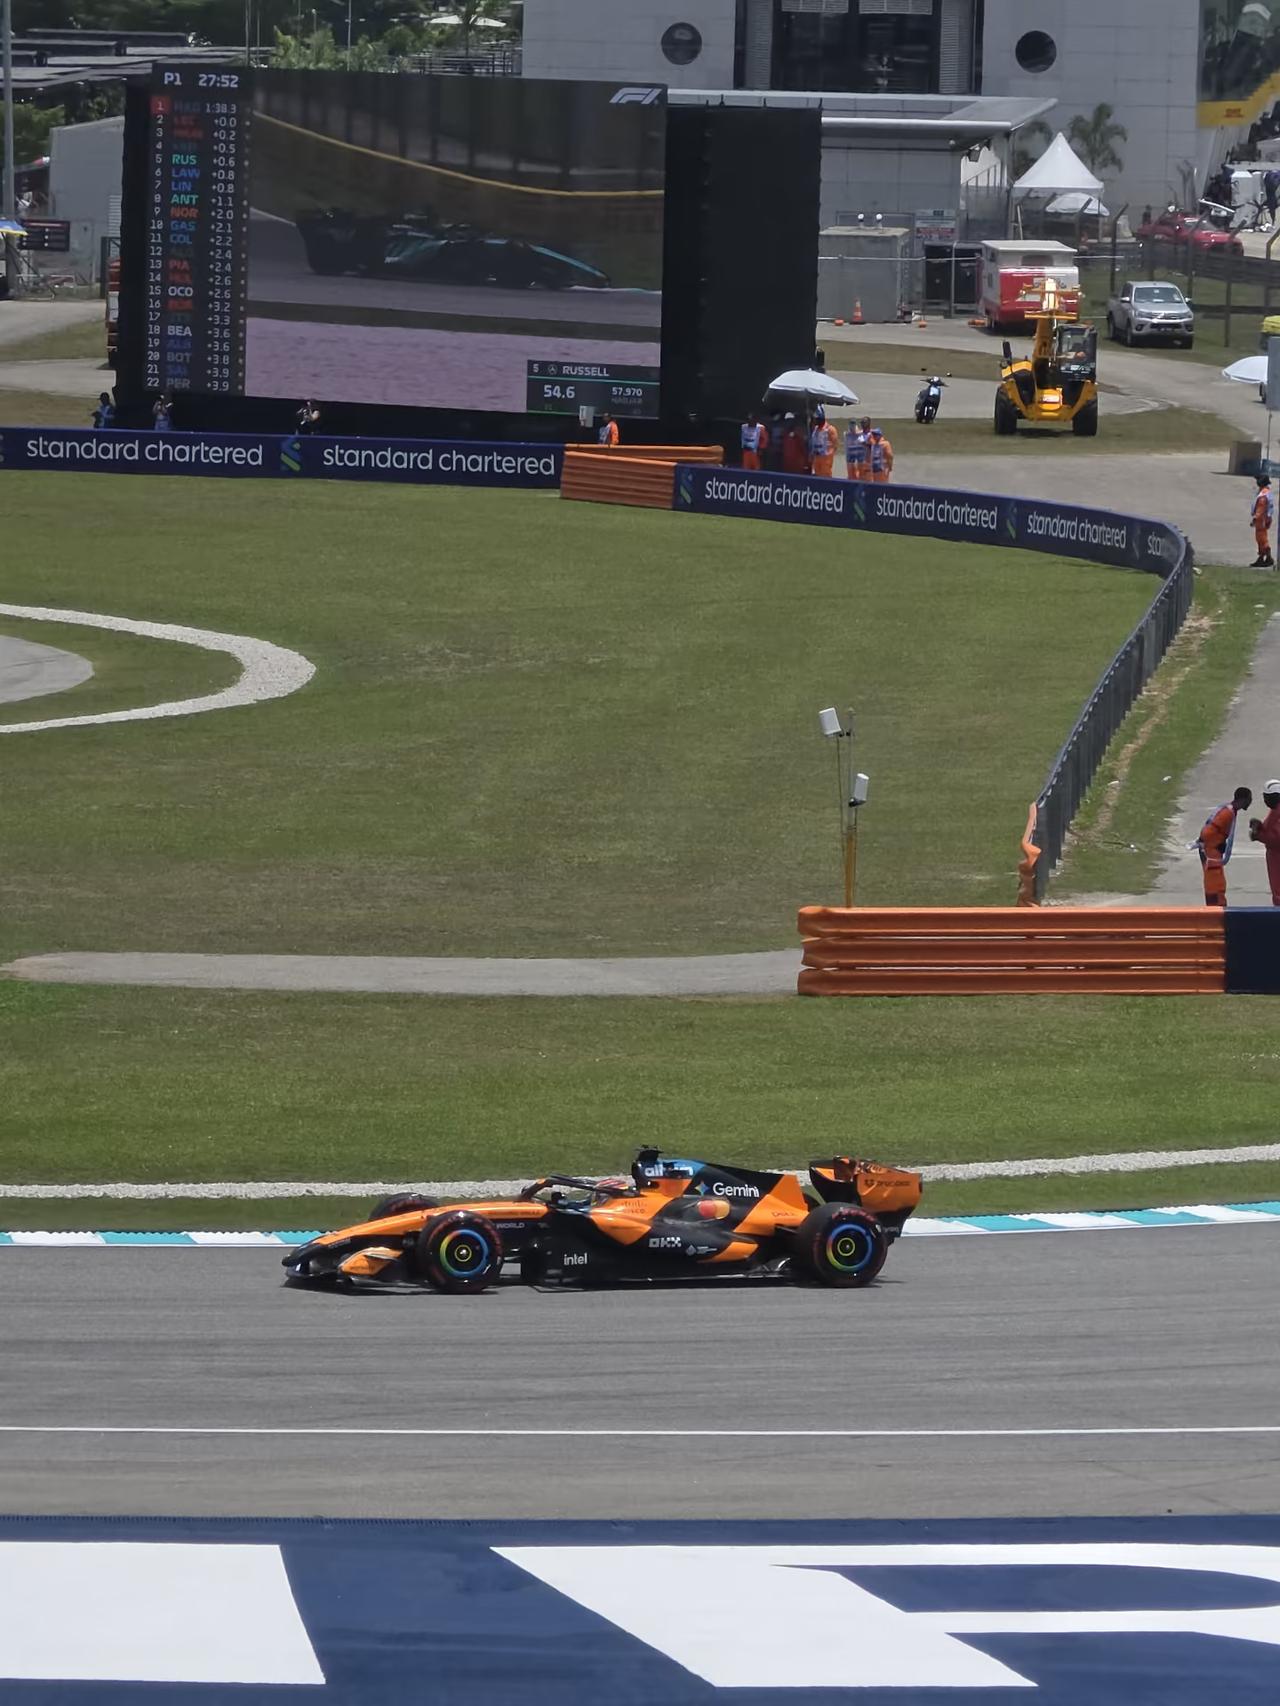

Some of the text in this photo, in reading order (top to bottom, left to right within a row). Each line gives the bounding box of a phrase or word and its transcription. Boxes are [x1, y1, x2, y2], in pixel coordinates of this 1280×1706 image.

[164, 72, 239, 88] P1 27:52
[156, 115, 164, 123] 2
[156, 128, 164, 136] 3
[155, 154, 163, 163] 5
[173, 154, 196, 165] RUS
[154, 168, 162, 176] 6
[172, 169, 199, 177] LAW
[154, 180, 162, 189] 7
[172, 181, 192, 191] LIN
[154, 194, 162, 202] 8
[171, 194, 198, 204] ANT
[154, 207, 161, 215] 9
[171, 207, 198, 217] NOR
[150, 220, 163, 229] 10
[171, 220, 195, 231] GAS
[150, 233, 161, 242] 11
[170, 233, 192, 244] COL
[150, 246, 162, 255] 12
[149, 259, 161, 268] 13
[148, 272, 160, 281] 14
[148, 286, 161, 295] 15
[168, 287, 193, 296] OCO
[148, 299, 160, 308] 16
[148, 312, 160, 321] 17
[148, 325, 160, 334] 18
[168, 326, 192, 336] BEA
[147, 338, 159, 347] 19
[147, 351, 159, 360] 20
[167, 352, 191, 362] BOT
[147, 364, 159, 373] 21
[532, 363, 610, 377] 5 RUSSELL
[146, 377, 159, 386] 22
[167, 377, 190, 388] PER
[543, 384, 643, 399] 54.6 57.970
[27, 436, 263, 466] standard chartered
[323, 444, 555, 475] standard chartered
[704, 476, 844, 513] standard chartered
[876, 493, 997, 530] standard chartered
[1027, 511, 1127, 549] standard chartered
[712, 1182, 760, 1198] Gemini
[496, 1222, 526, 1230] WORLD
[648, 1236, 682, 1248] OKX
[563, 1252, 588, 1266] intel
